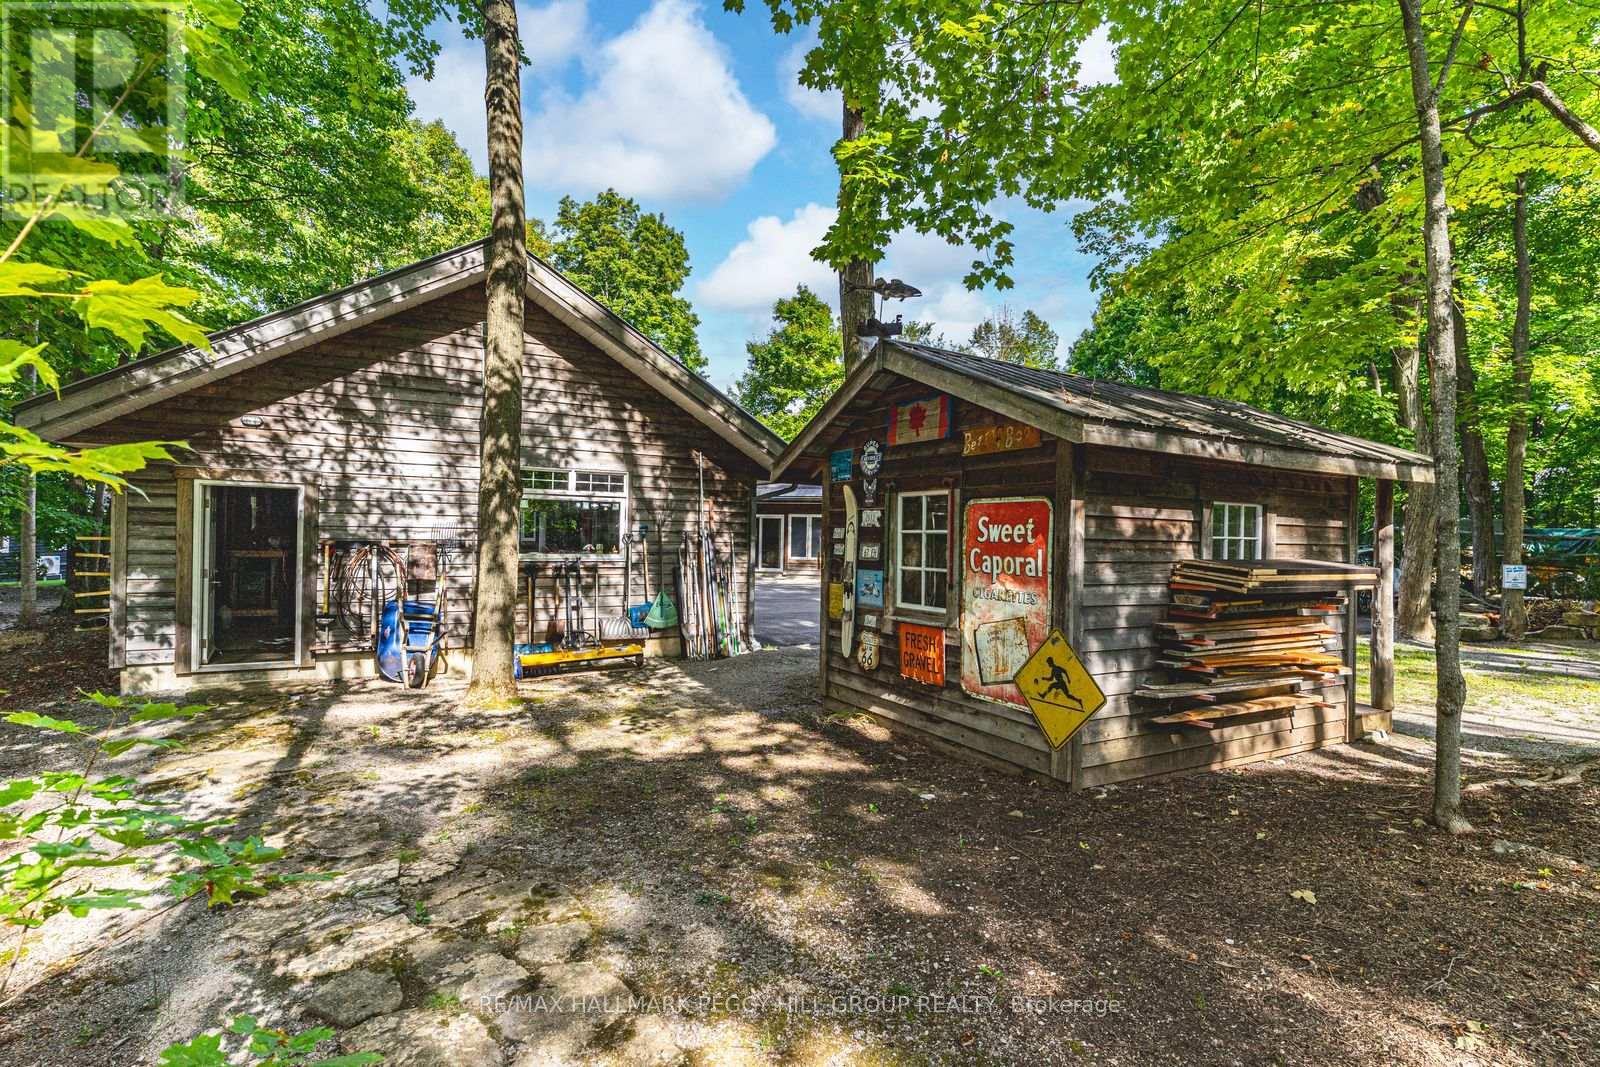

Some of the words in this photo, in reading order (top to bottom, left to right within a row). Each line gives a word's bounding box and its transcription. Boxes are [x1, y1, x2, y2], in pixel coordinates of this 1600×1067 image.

[977, 516, 1036, 544] Sweet
[969, 547, 1044, 584] Caporal
[905, 631, 936, 653] FRESH
[862, 651, 873, 665] 66
[903, 651, 939, 674] GRAVEL
